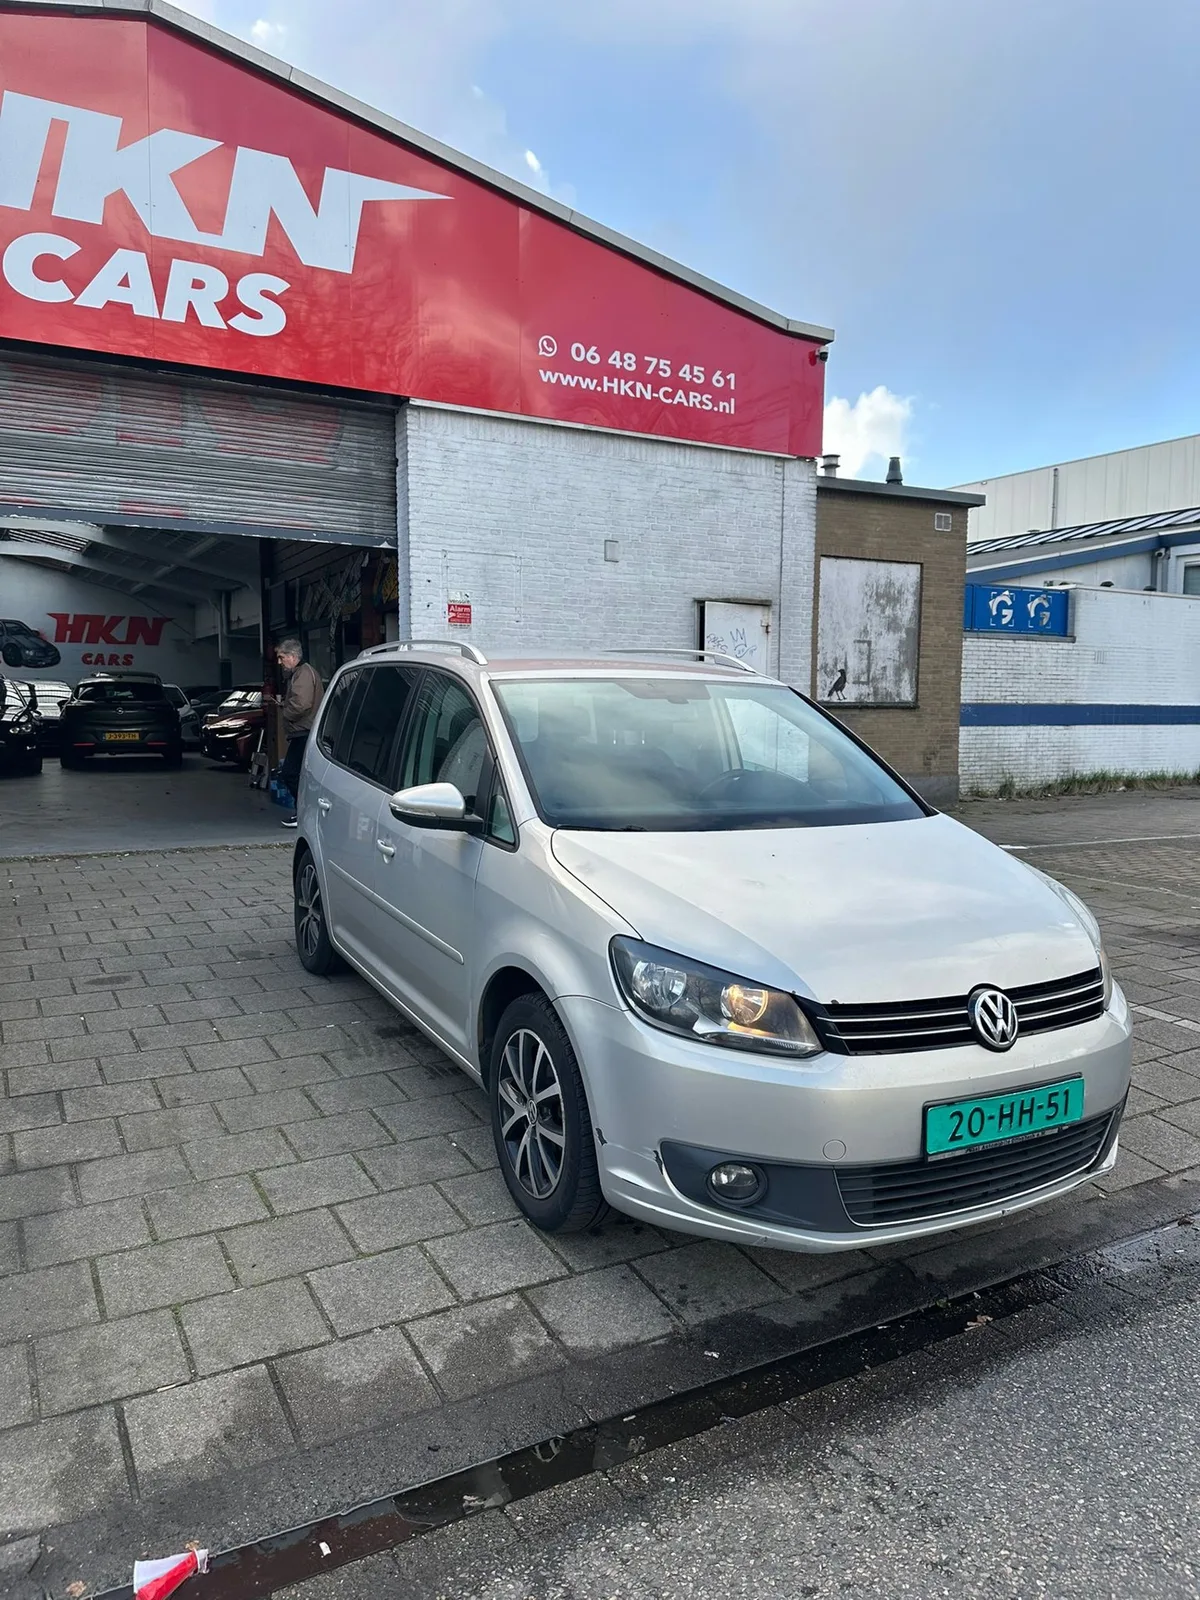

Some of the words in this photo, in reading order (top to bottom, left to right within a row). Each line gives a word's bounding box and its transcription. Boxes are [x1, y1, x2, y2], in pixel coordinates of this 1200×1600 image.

[2, 232, 291, 337] CARS
[570, 342, 601, 365] 06
[608, 350, 637, 371] 48
[643, 356, 672, 378] 75
[678, 363, 705, 384] 45
[711, 370, 736, 390] 61
[538, 368, 735, 415] www.HKN-CARS.nl
[46, 613, 175, 646] HKN
[81, 652, 135, 666] CARS
[948, 1088, 1070, 1143] 20-HH-51
